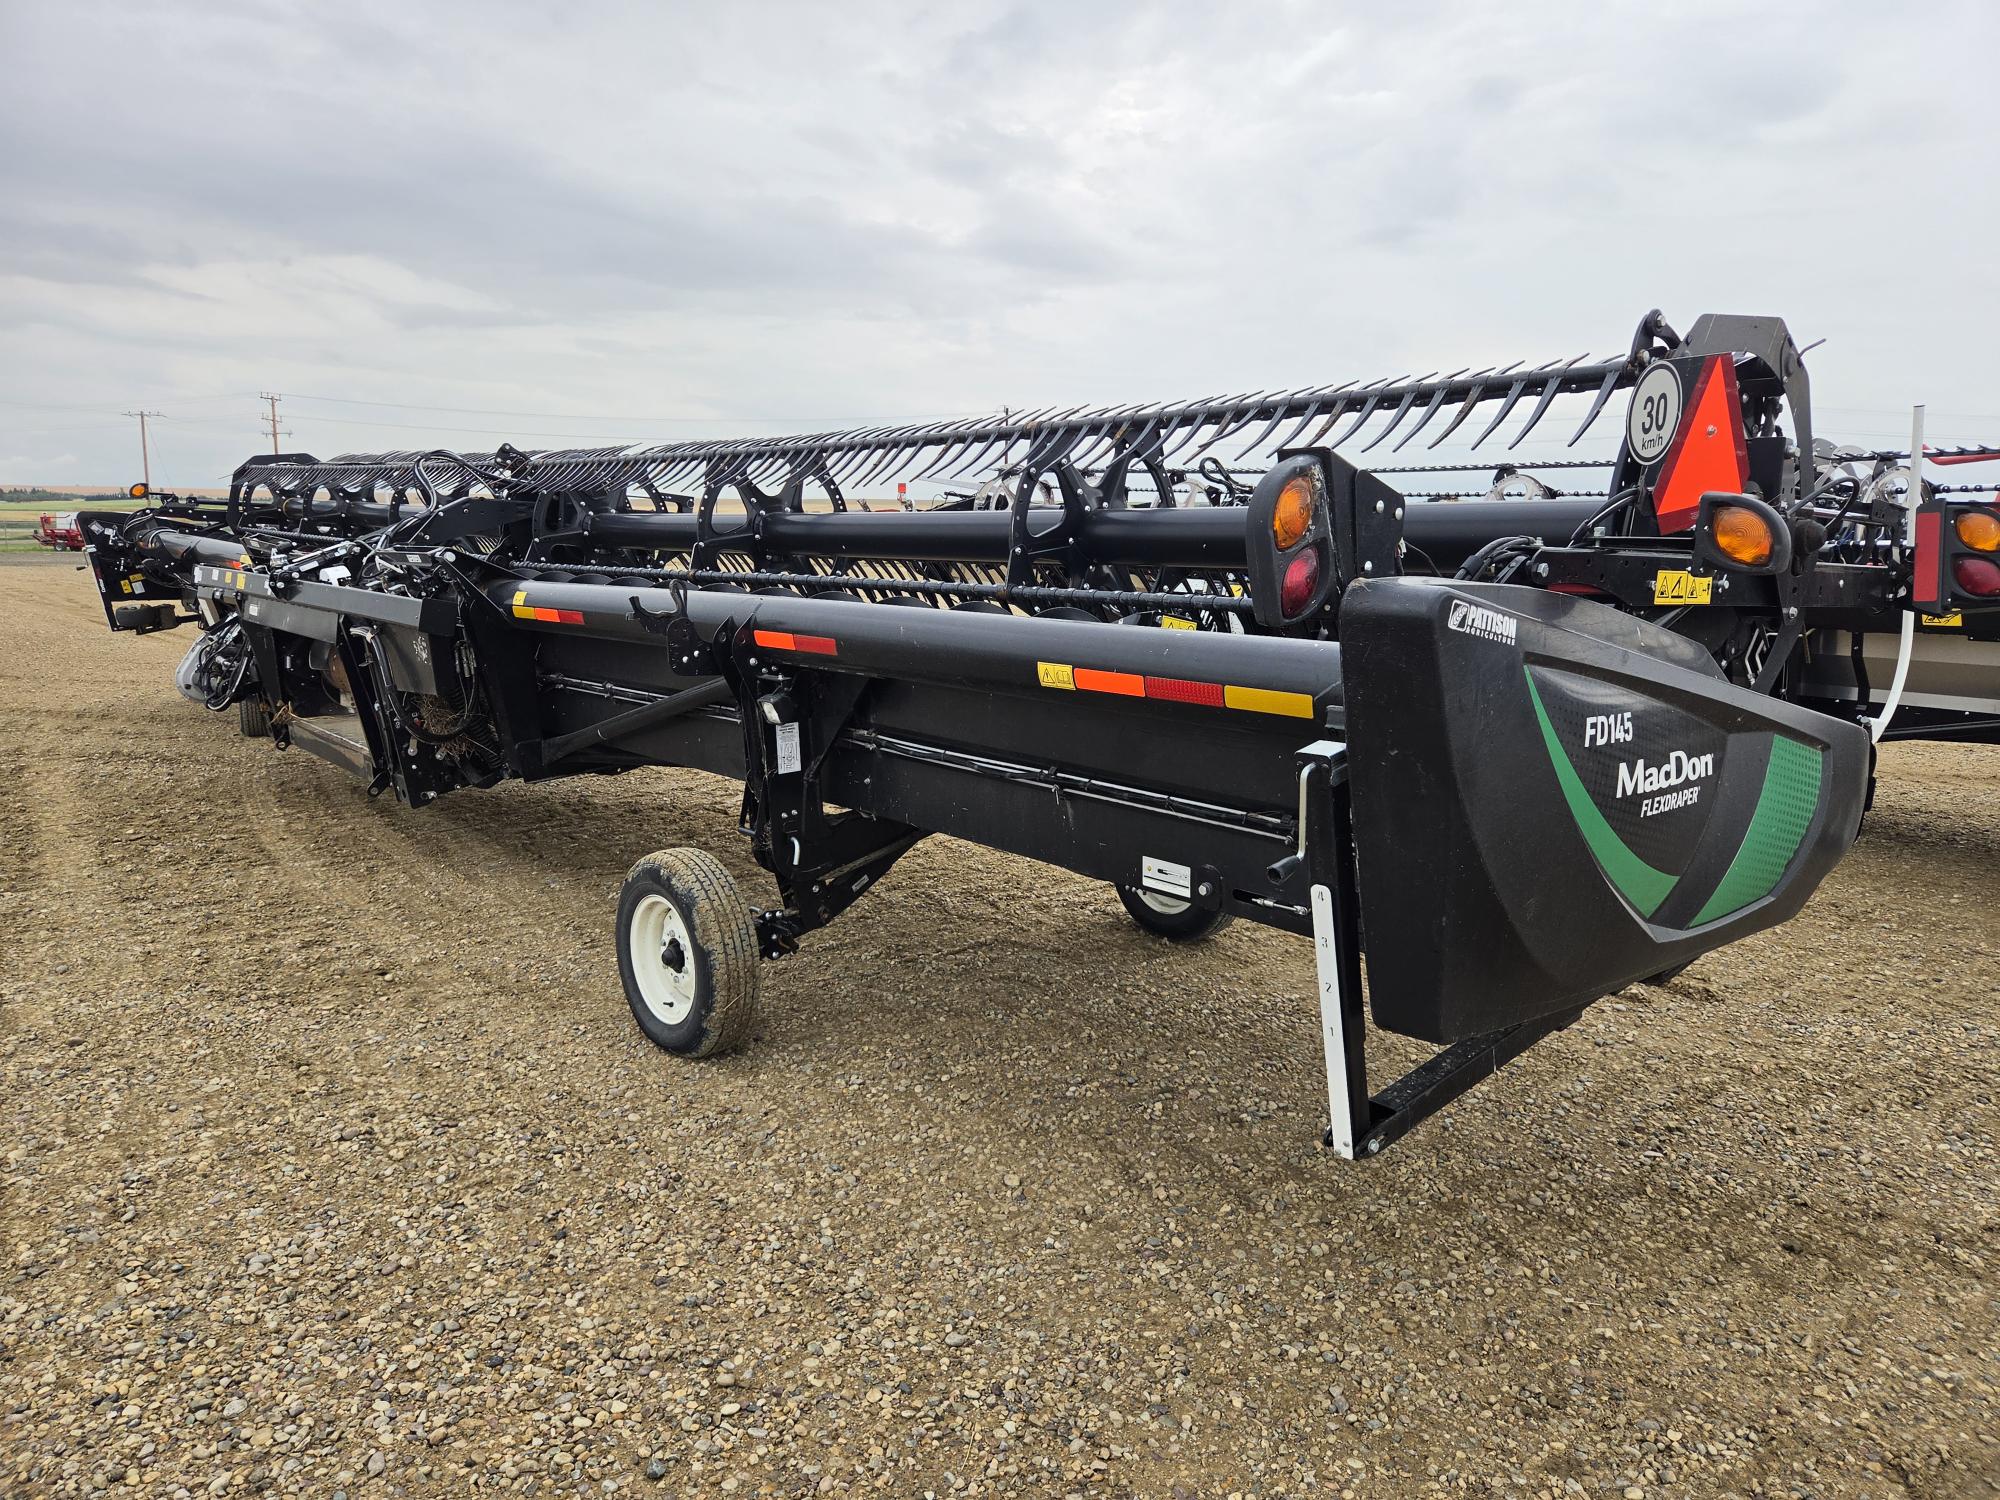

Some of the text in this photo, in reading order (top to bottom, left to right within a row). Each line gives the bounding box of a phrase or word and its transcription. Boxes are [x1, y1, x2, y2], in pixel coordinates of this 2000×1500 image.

[1641, 392, 1668, 435] 30
[1641, 433, 1663, 451] km/h
[1467, 604, 1517, 639] PATTISON
[1465, 625, 1516, 646] AGRICULTURE
[1584, 711, 1633, 748] FD145
[1616, 750, 1714, 799] MacDon
[1640, 786, 1700, 818] FLEXDRAPER
[1317, 890, 1325, 902] 4
[1321, 936, 1328, 949] 3
[1325, 981, 1332, 993] 2
